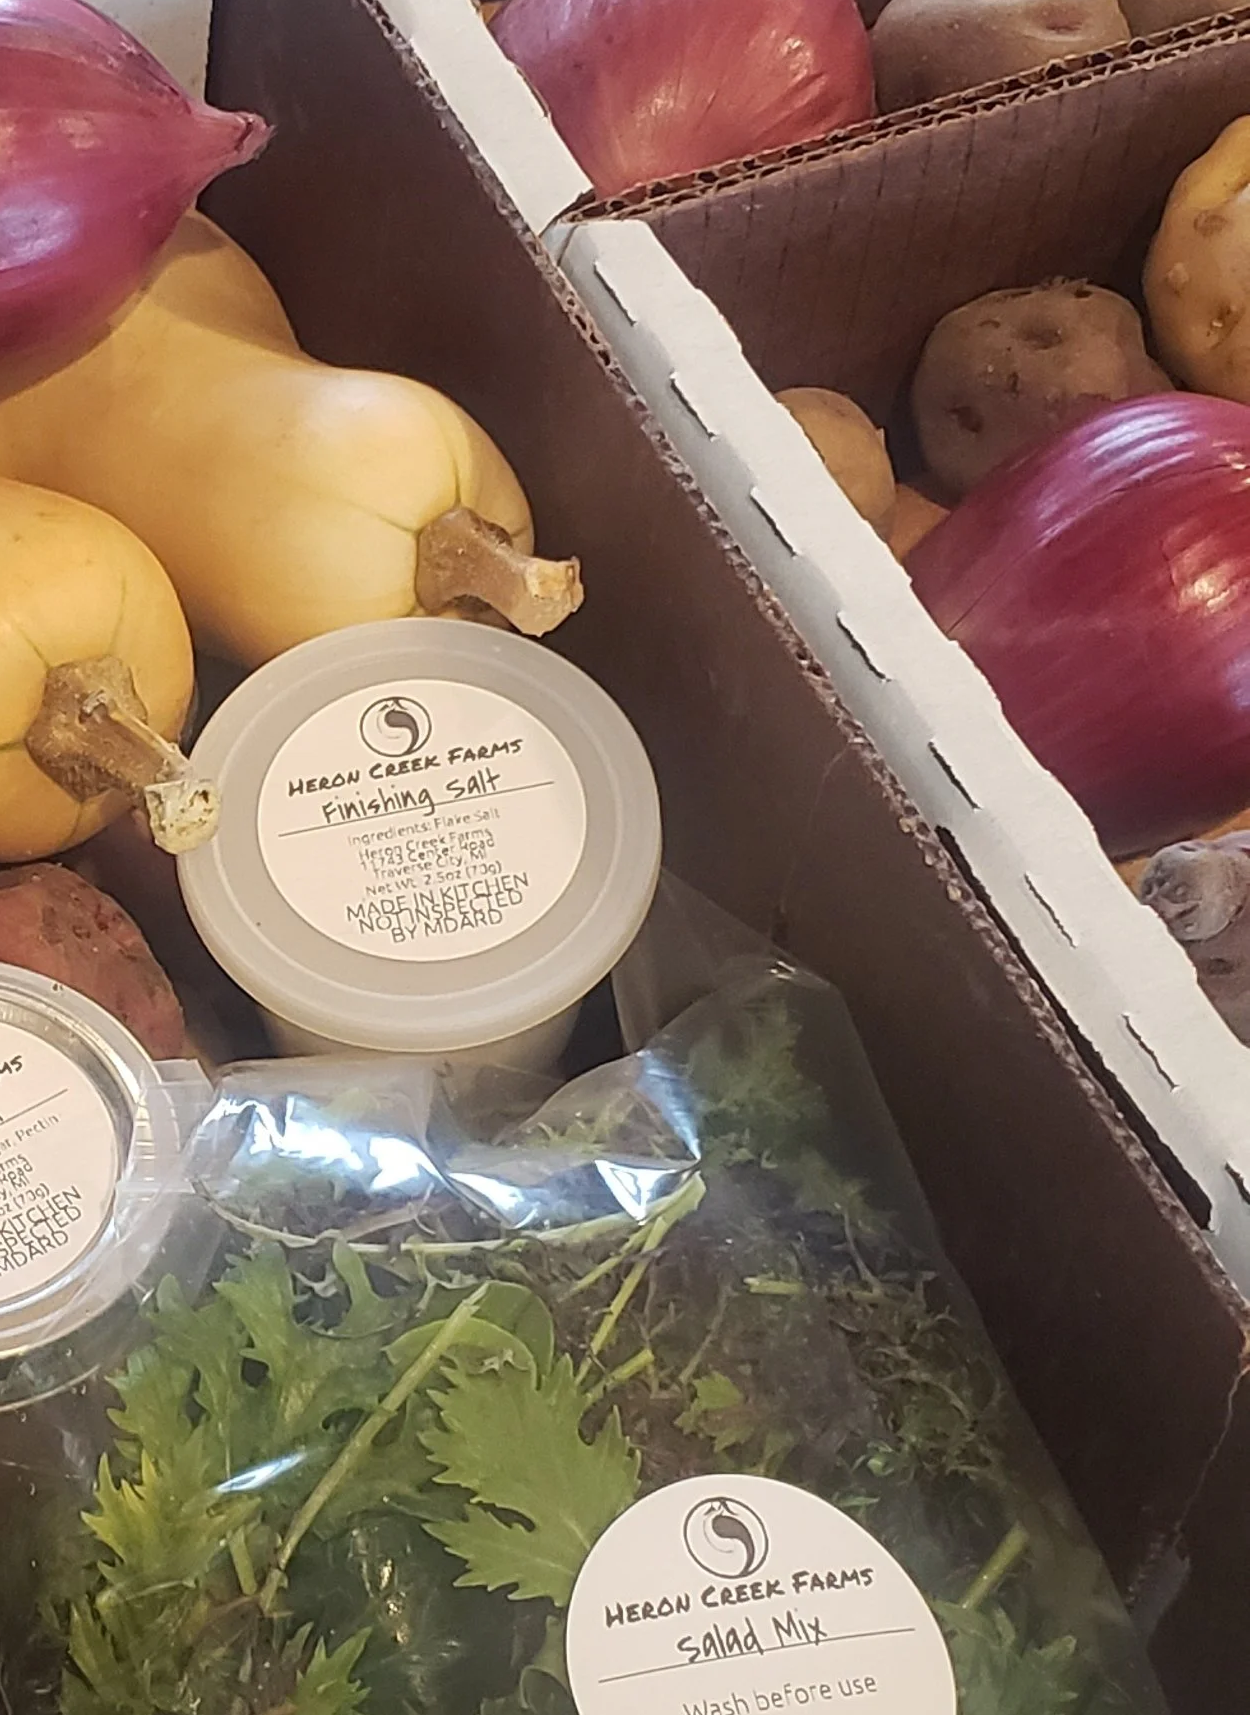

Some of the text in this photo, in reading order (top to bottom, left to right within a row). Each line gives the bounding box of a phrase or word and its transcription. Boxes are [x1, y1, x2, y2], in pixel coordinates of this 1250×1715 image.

[288, 738, 523, 797] HERON CREEK FARMS
[321, 784, 436, 824] Finishing
[349, 823, 432, 847] Ingredients:
[347, 871, 530, 922] MADE IN KITCHEN
[358, 888, 523, 934] NOT INSPECTED
[391, 908, 503, 943] BY MDARD
[15, 1115, 60, 1142] Pectin
[603, 1566, 875, 1629] HERON CREEK FARMS
[771, 1607, 829, 1647] Mix
[754, 1678, 833, 1713] before
[838, 1674, 879, 1699] use
